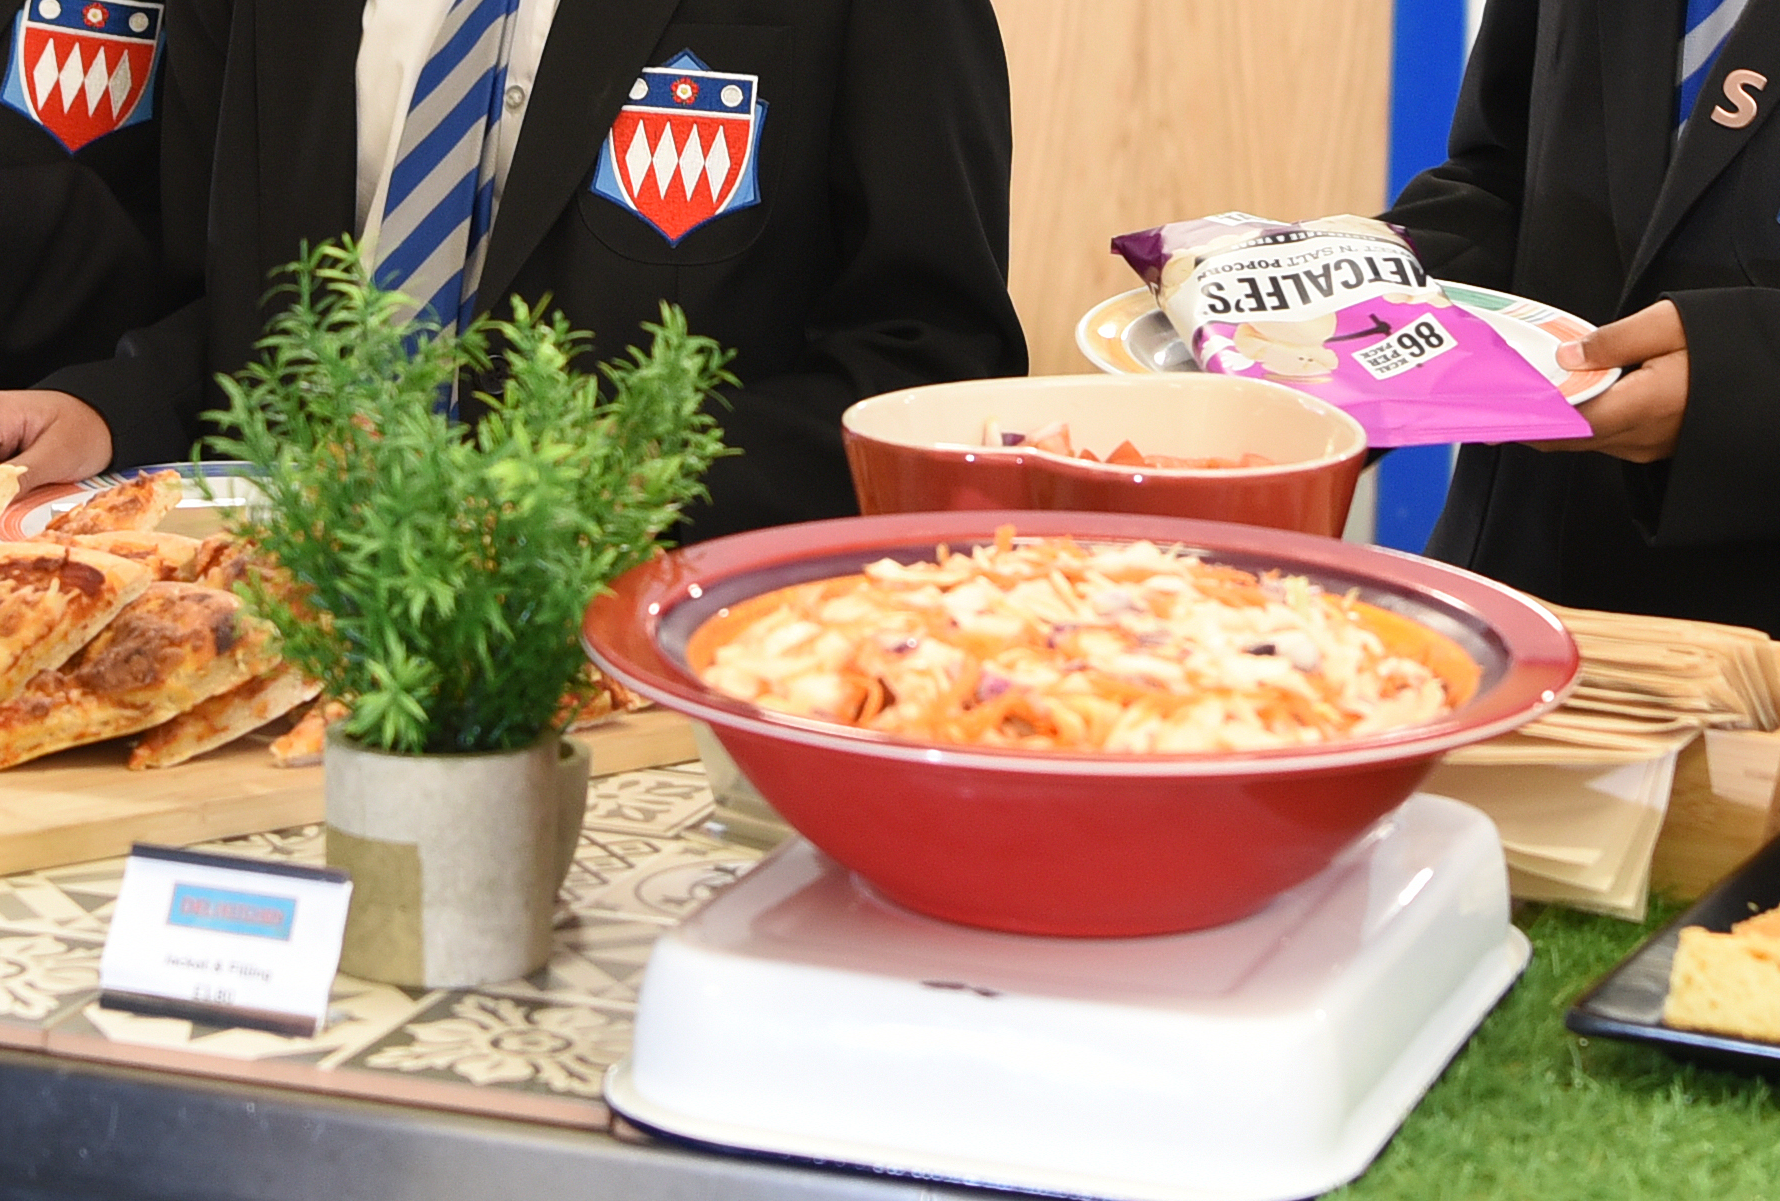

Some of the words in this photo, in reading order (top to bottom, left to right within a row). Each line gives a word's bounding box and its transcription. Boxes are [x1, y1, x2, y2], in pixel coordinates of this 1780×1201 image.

[1710, 68, 1768, 129] S
[1287, 246, 1334, 267] SALT
[1196, 259, 1282, 281] POPCORN
[1397, 321, 1444, 358] 86
[1359, 342, 1393, 359] PACK
[1366, 349, 1402, 367] PER
[1375, 357, 1409, 373] KCAL
